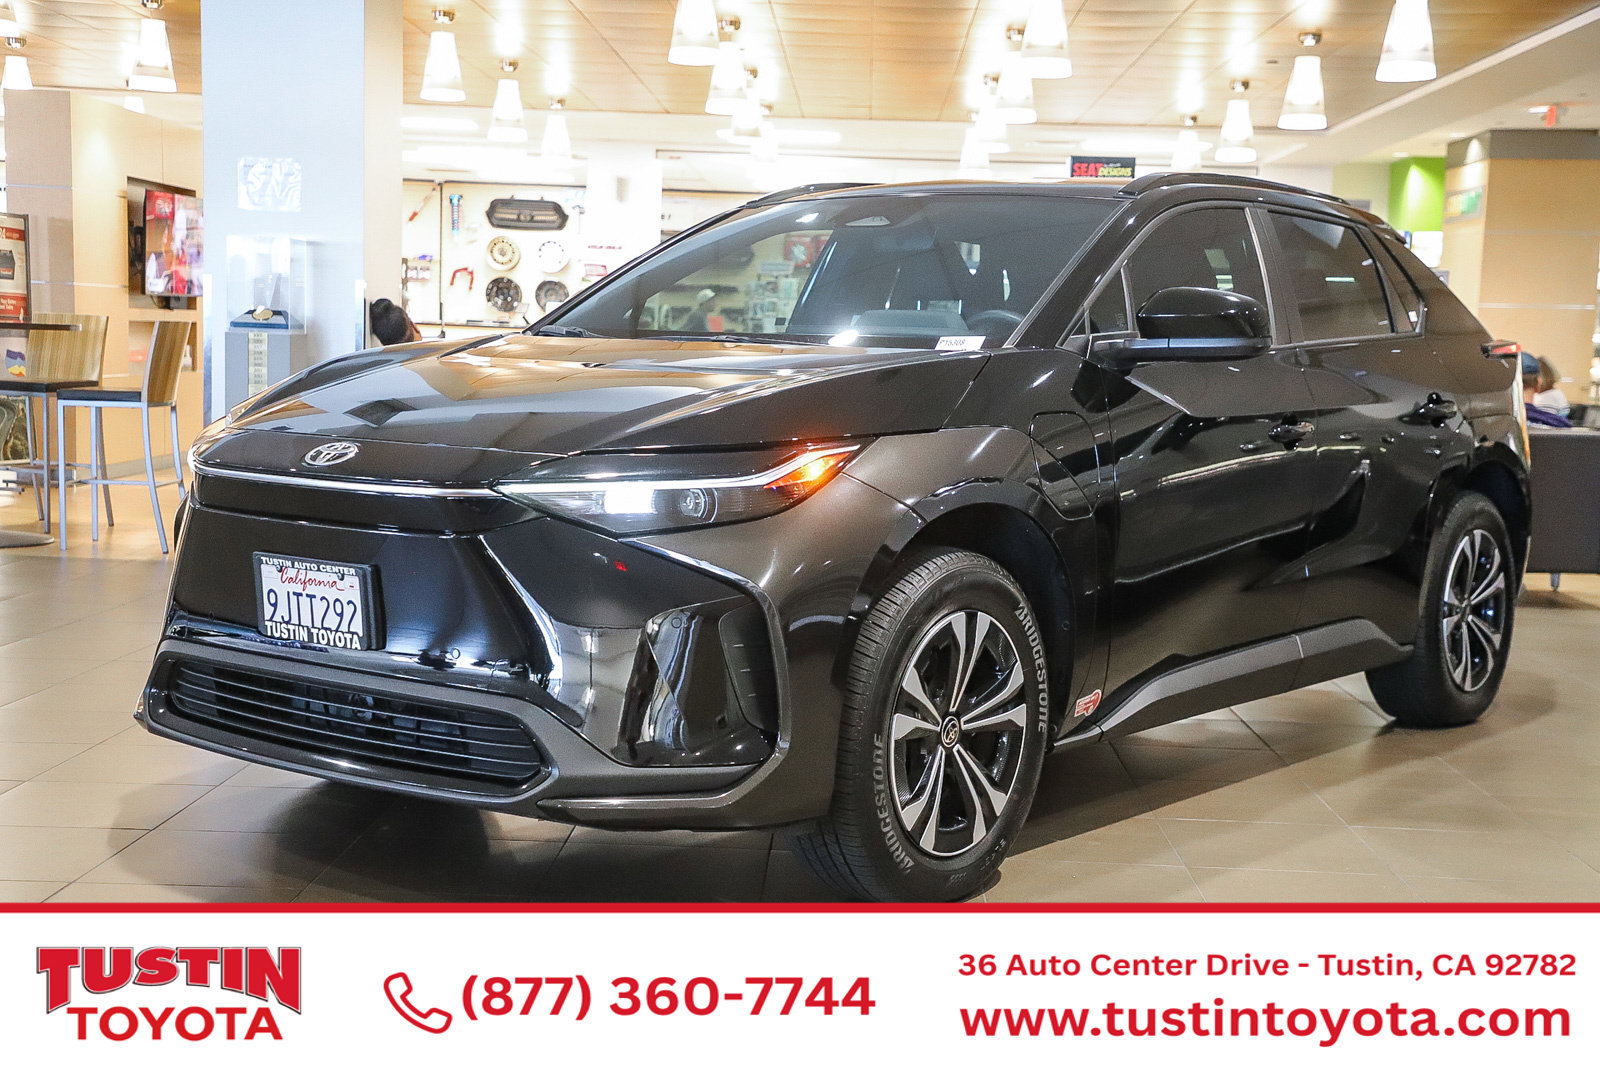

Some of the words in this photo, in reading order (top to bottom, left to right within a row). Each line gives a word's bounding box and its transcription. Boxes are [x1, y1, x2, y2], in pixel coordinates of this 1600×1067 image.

[1073, 162, 1104, 176] SEAT
[261, 557, 292, 568] TUSTIN
[294, 561, 318, 571] AUTO
[320, 564, 356, 576] CENTER
[280, 567, 345, 592] California
[266, 588, 358, 633] 9JTT292
[265, 621, 308, 642] TUSTIN
[311, 626, 361, 650] TOYOTA
[1014, 601, 1050, 733] BRIDGESTONE
[872, 733, 915, 875] BRIDGESTONE
